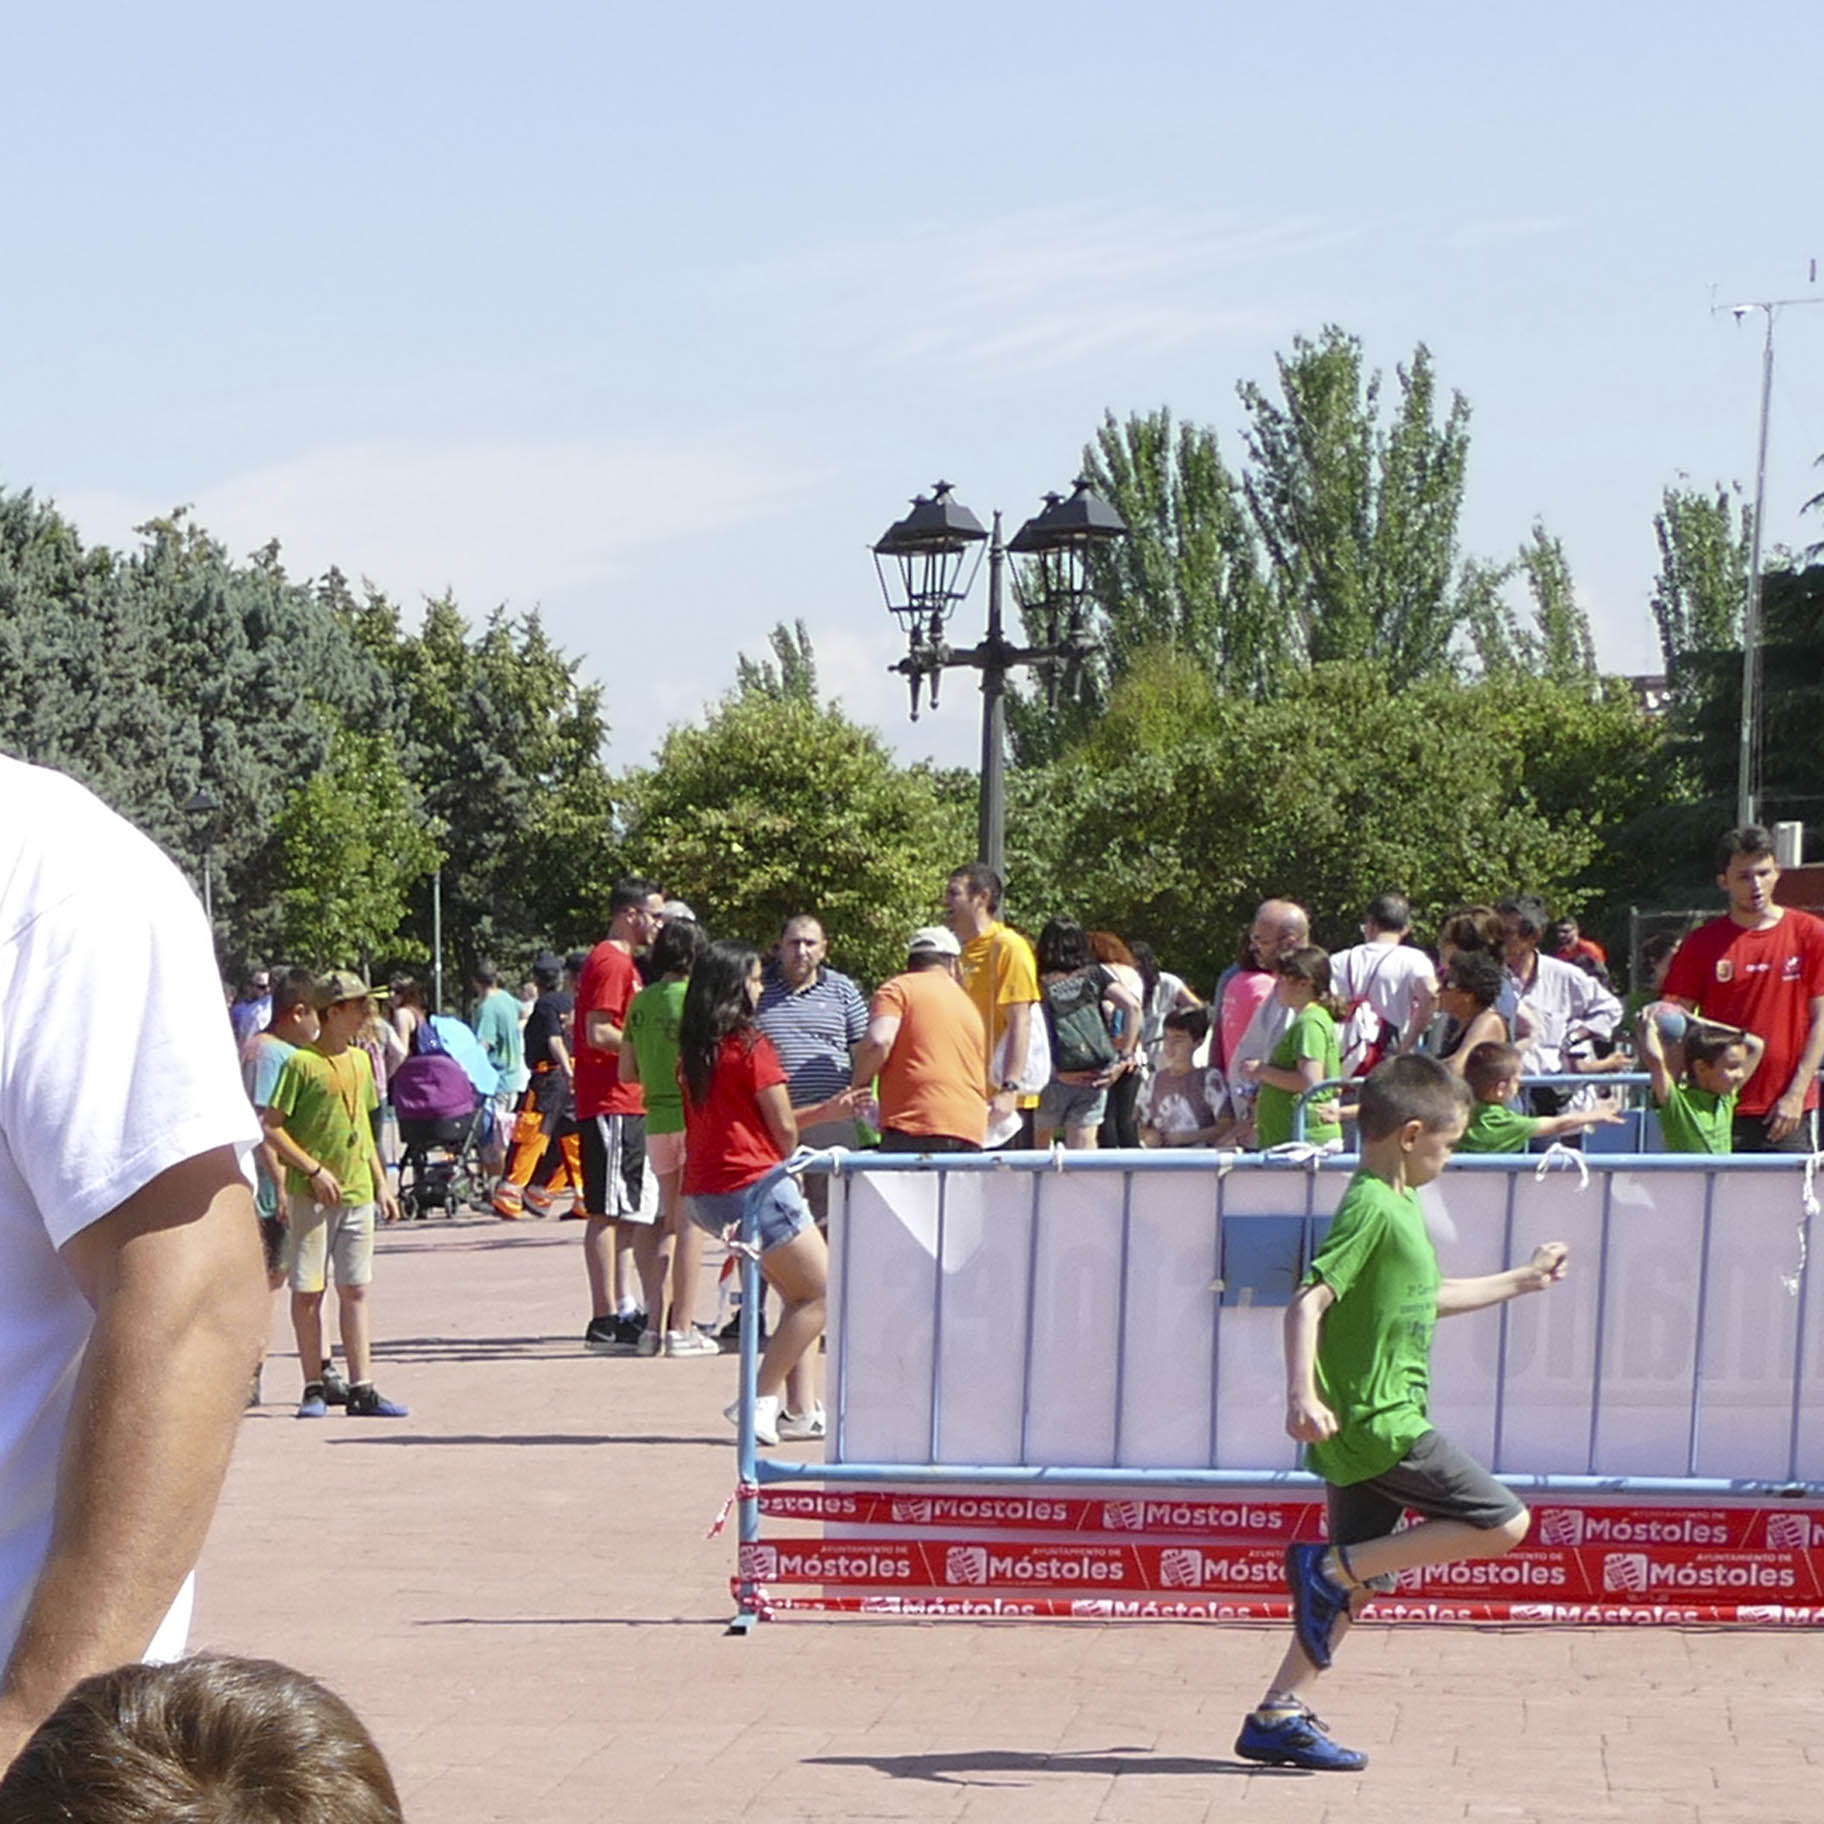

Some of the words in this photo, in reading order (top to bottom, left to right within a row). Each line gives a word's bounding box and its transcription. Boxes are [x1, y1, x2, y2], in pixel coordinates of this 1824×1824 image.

[779, 1551, 911, 1578] Móstoles
[989, 1555, 1124, 1580] Móstoles
[1424, 1560, 1566, 1585] Móstoles
[1651, 1563, 1795, 1587] Móstoles
